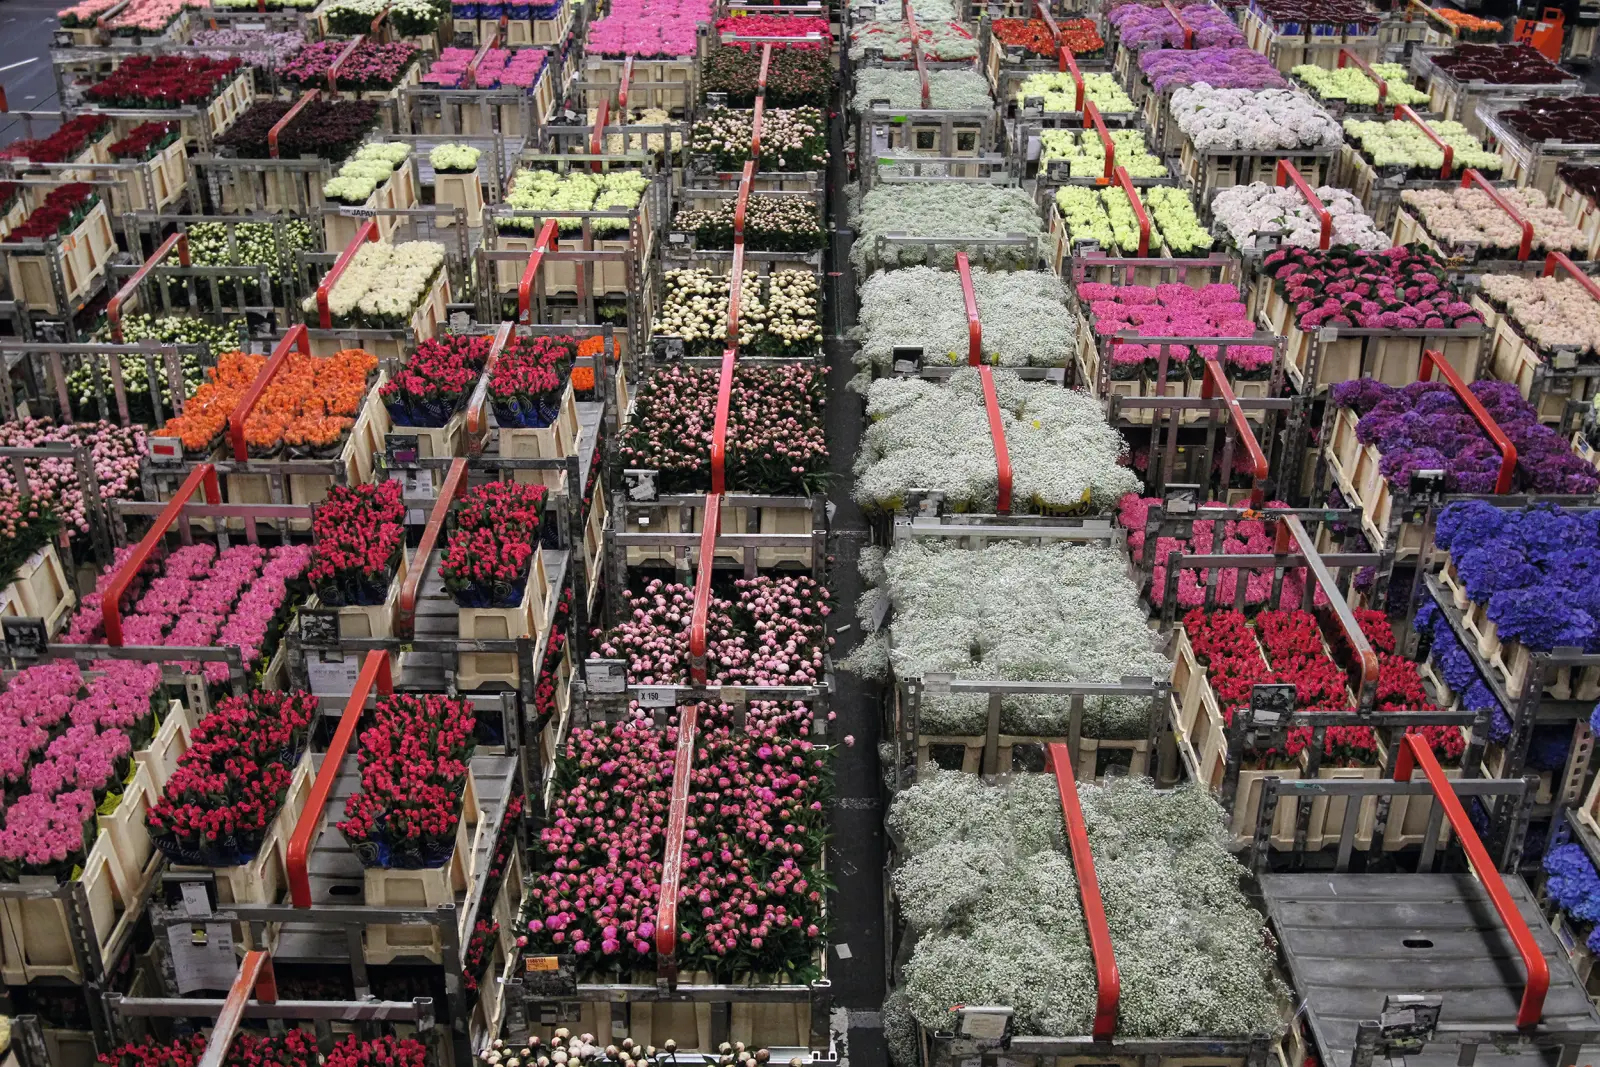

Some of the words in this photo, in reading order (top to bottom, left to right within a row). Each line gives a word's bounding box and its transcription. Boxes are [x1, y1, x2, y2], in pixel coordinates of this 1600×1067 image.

[1523, 22, 1536, 35] H
[352, 209, 376, 217] JAPAN
[641, 692, 646, 700] X
[648, 692, 659, 701] 150
